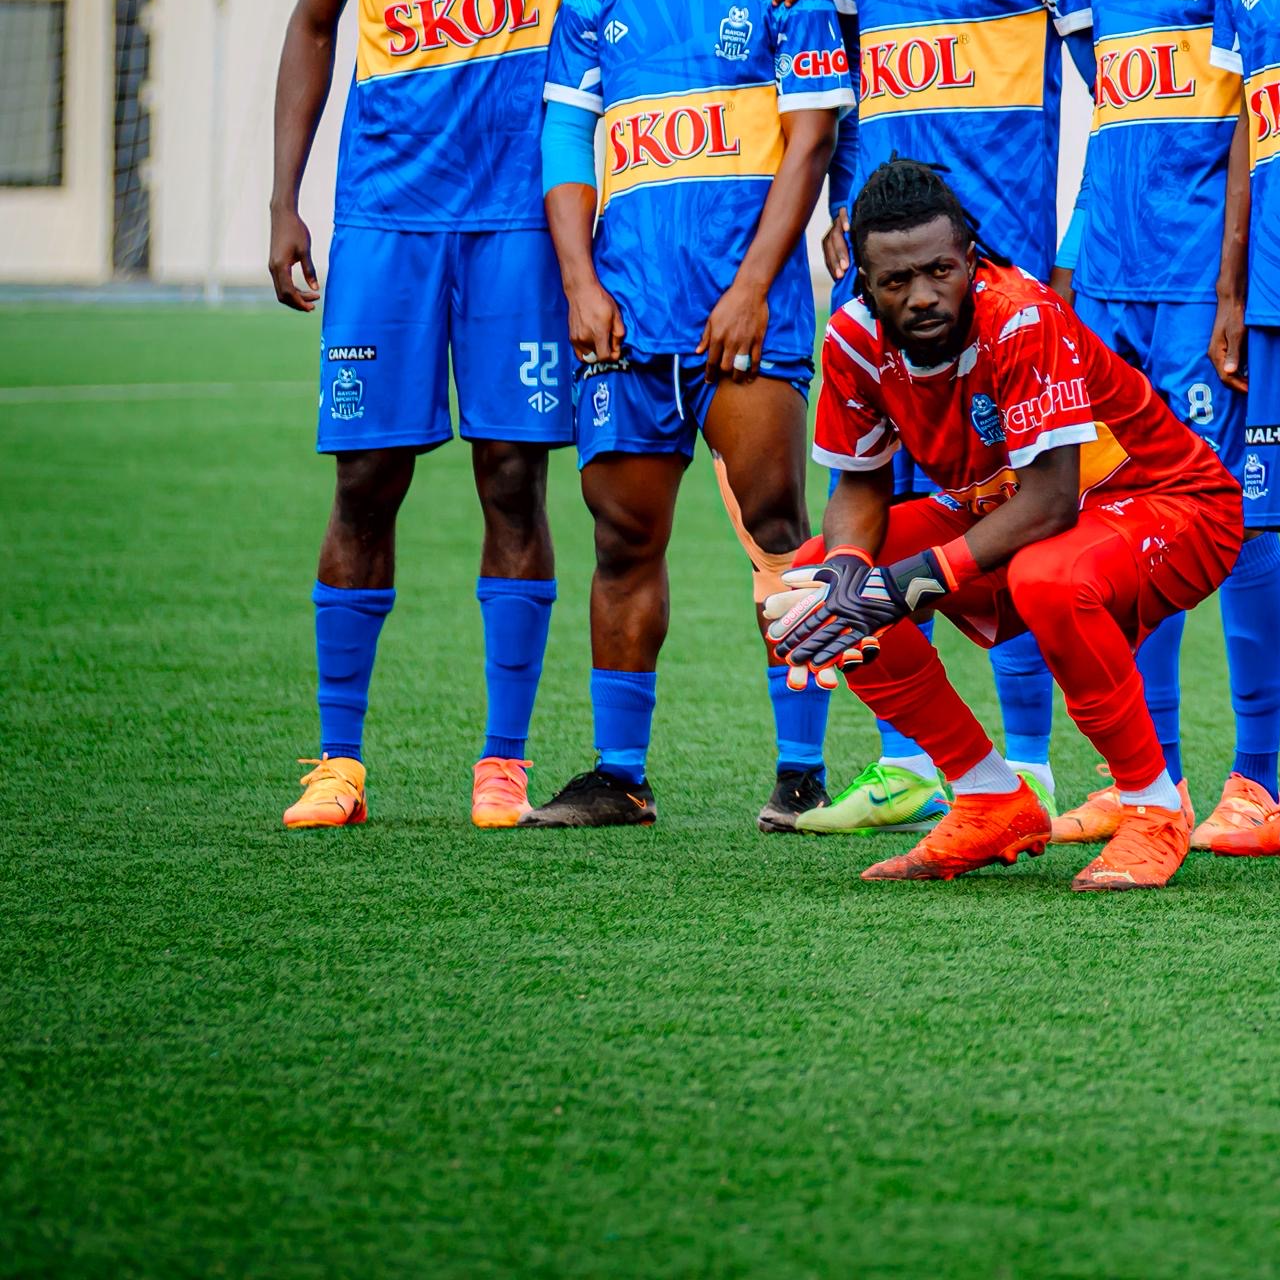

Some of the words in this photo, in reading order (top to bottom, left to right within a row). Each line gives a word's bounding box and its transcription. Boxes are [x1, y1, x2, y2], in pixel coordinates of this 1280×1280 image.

[610, 103, 740, 176] SKOL
[329, 347, 375, 360] CANAL+
[519, 342, 559, 387] 22
[1188, 383, 1214, 424] 8
